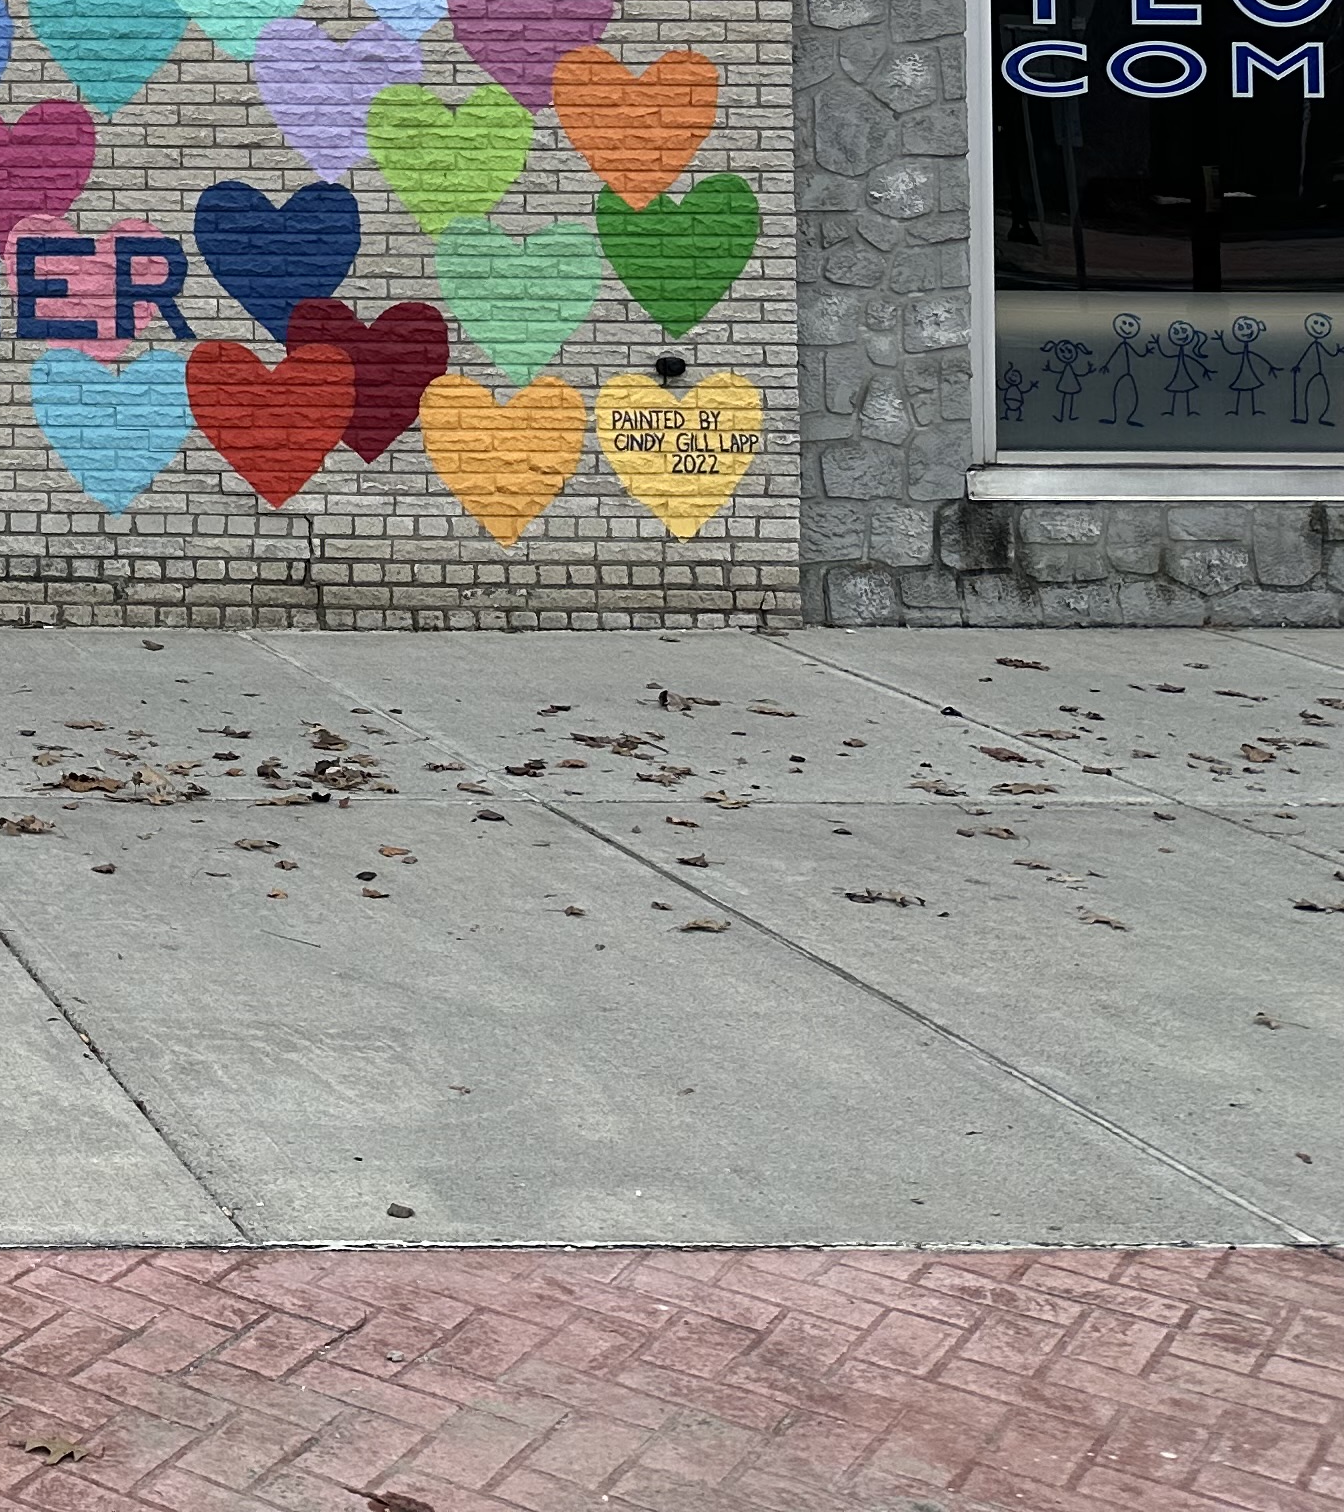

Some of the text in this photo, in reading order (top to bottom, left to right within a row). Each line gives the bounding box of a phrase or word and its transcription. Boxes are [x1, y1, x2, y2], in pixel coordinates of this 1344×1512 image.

[612, 410, 721, 430] PAINTED BY
[614, 432, 759, 453] CINDY GILL LAPP
[672, 454, 720, 474] 2022
